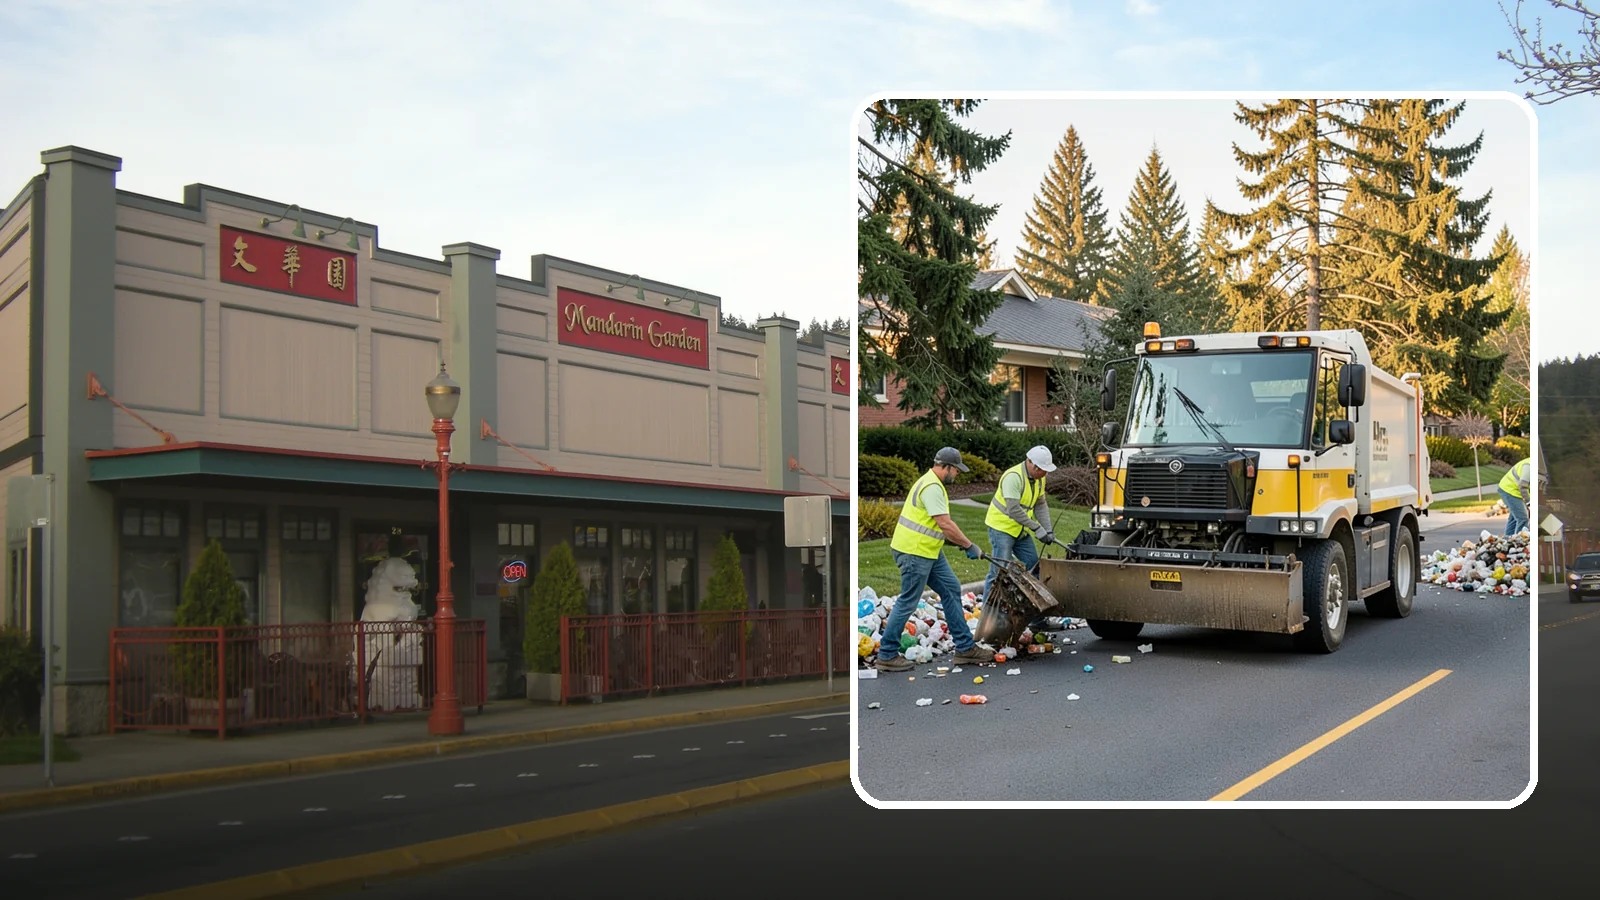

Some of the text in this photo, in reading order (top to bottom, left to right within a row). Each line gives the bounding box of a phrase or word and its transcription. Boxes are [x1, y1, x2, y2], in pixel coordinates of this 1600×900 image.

[231, 236, 346, 291] 文華園
[564, 302, 701, 352] Mandarin Garden
[503, 565, 527, 578] OPEN
